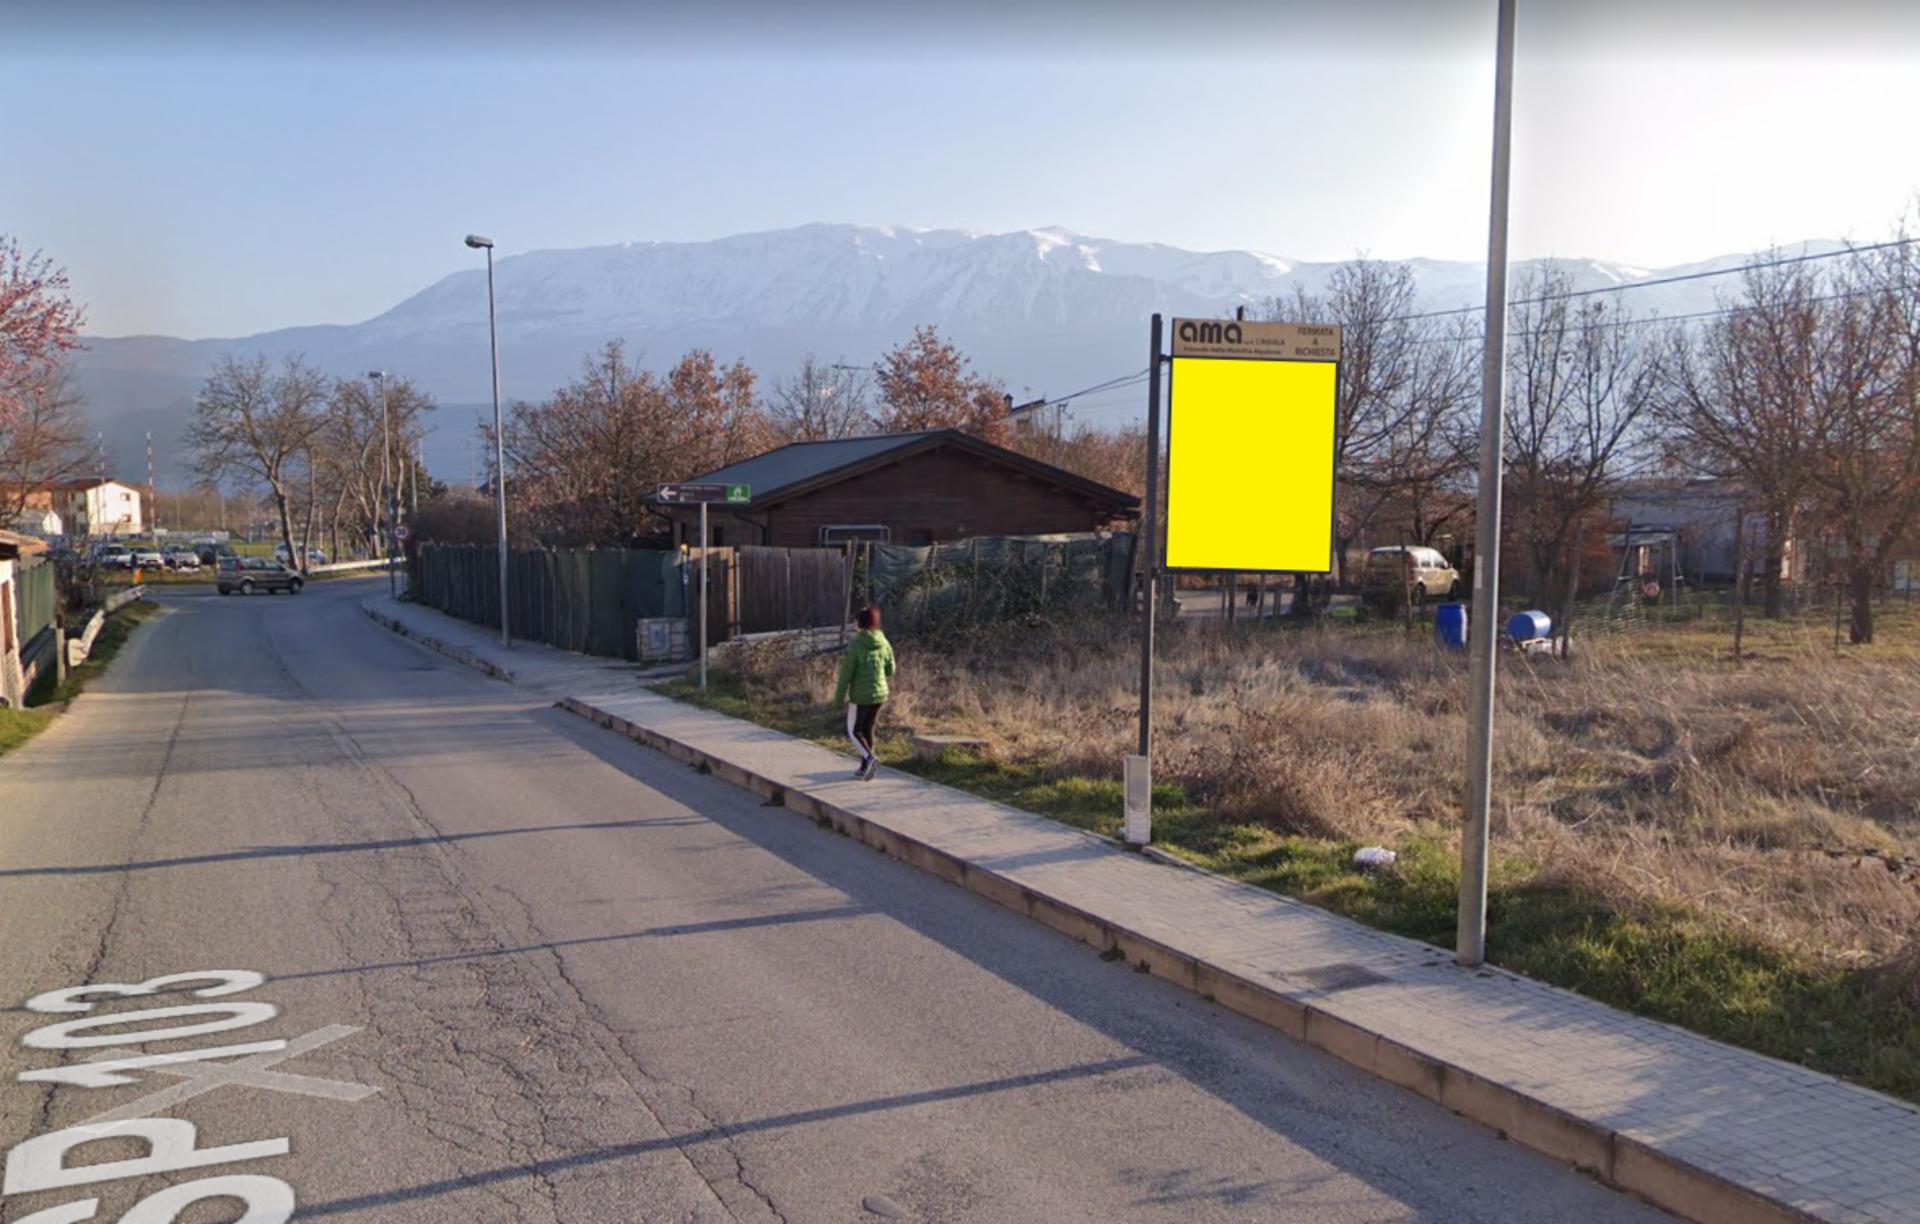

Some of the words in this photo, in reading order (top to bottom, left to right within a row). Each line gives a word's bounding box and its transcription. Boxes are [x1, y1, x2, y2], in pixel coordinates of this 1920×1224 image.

[1179, 321, 1242, 344] ama
[1297, 326, 1334, 336] FERMATA
[1295, 346, 1335, 356] RICHIESTA
